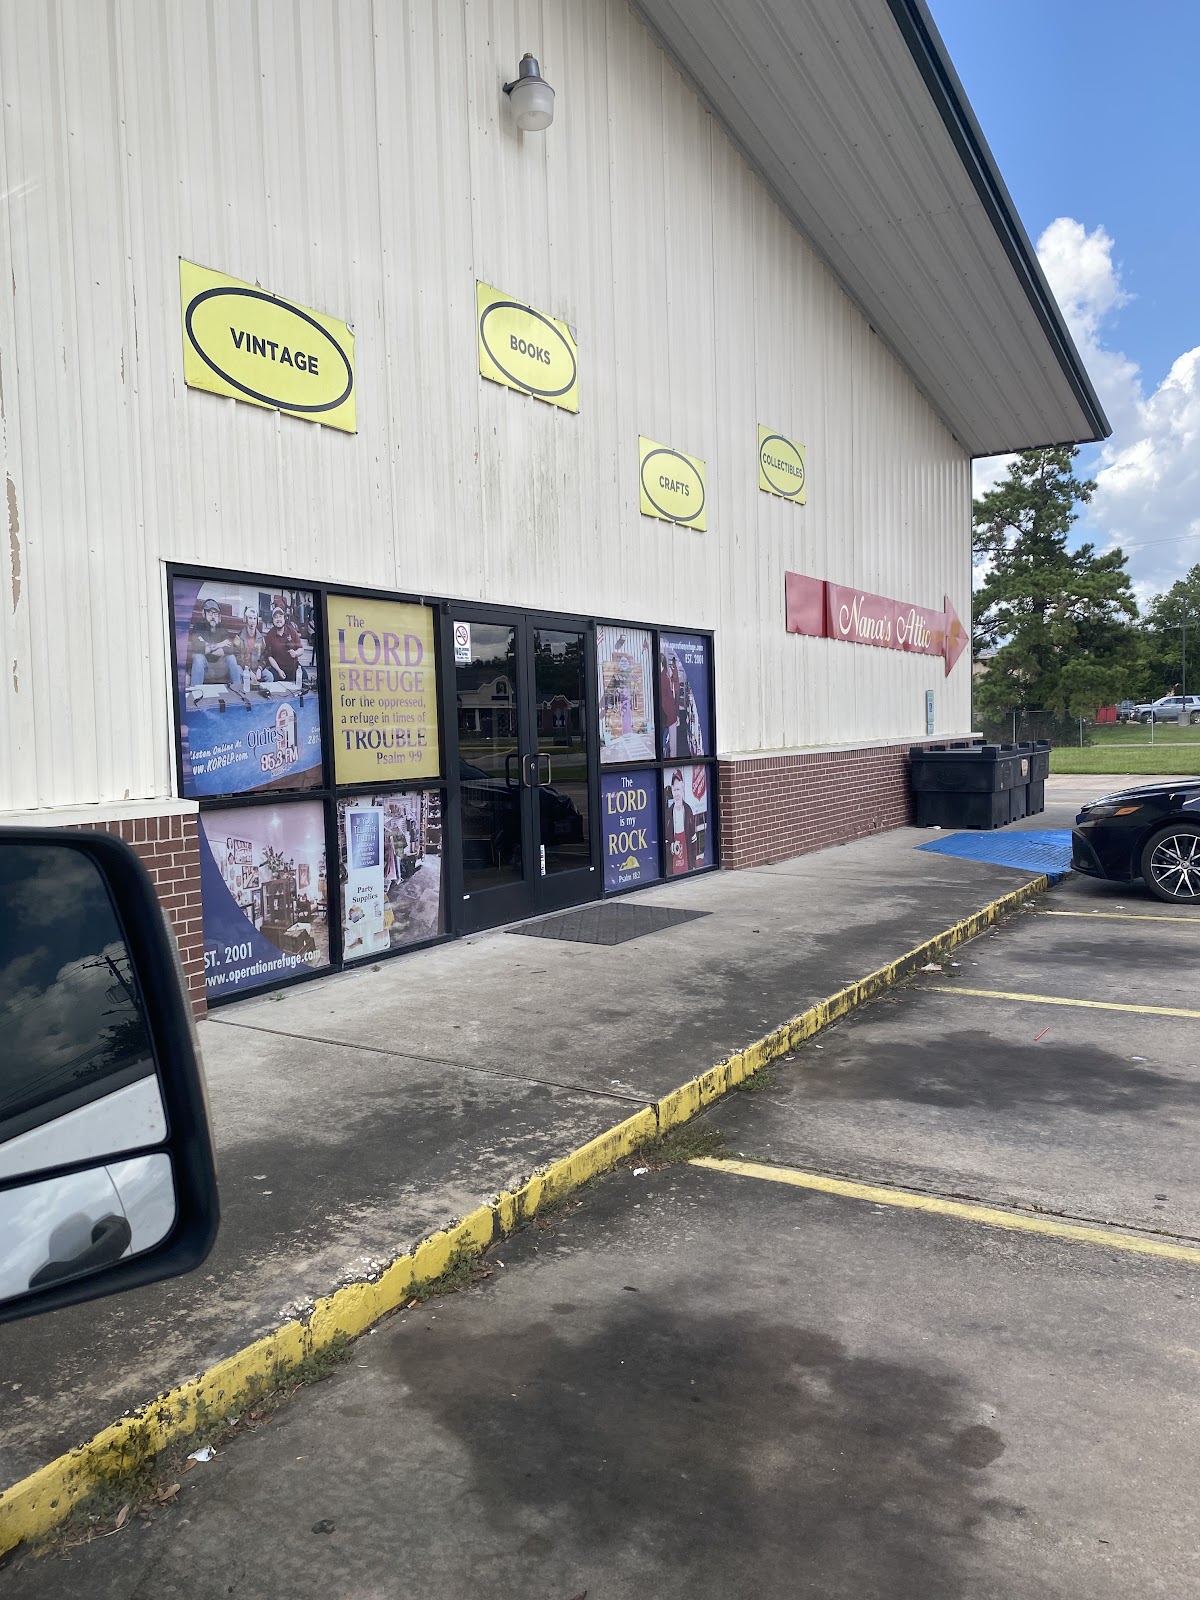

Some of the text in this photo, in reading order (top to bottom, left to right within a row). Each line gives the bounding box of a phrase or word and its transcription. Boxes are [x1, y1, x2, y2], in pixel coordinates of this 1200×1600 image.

[230, 326, 319, 376] VINTAGE
[509, 334, 551, 366] BOOKS
[762, 452, 803, 479] COLLECTIBLES
[658, 475, 690, 497] CRAFTS
[346, 615, 364, 628] The
[839, 595, 931, 649] Nana's Attic
[337, 629, 423, 667] LORD
[339, 669, 425, 693] is a REFUGE
[340, 695, 426, 710] for the oppressed,
[341, 711, 427, 726] a refuge in times of
[212, 743, 234, 755] Online
[247, 726, 284, 749] Oldies
[342, 727, 428, 750] TROUBLE
[261, 750, 283, 772] 95.3
[284, 745, 299, 763] FM
[376, 752, 405, 765] Psalm
[620, 776, 634, 788] The
[607, 788, 648, 815] LORD
[619, 815, 636, 828] is my
[608, 828, 648, 856] ROCK
[352, 893, 378, 904] Supplies
[357, 885, 373, 894] Party
[224, 941, 253, 964] 2001
